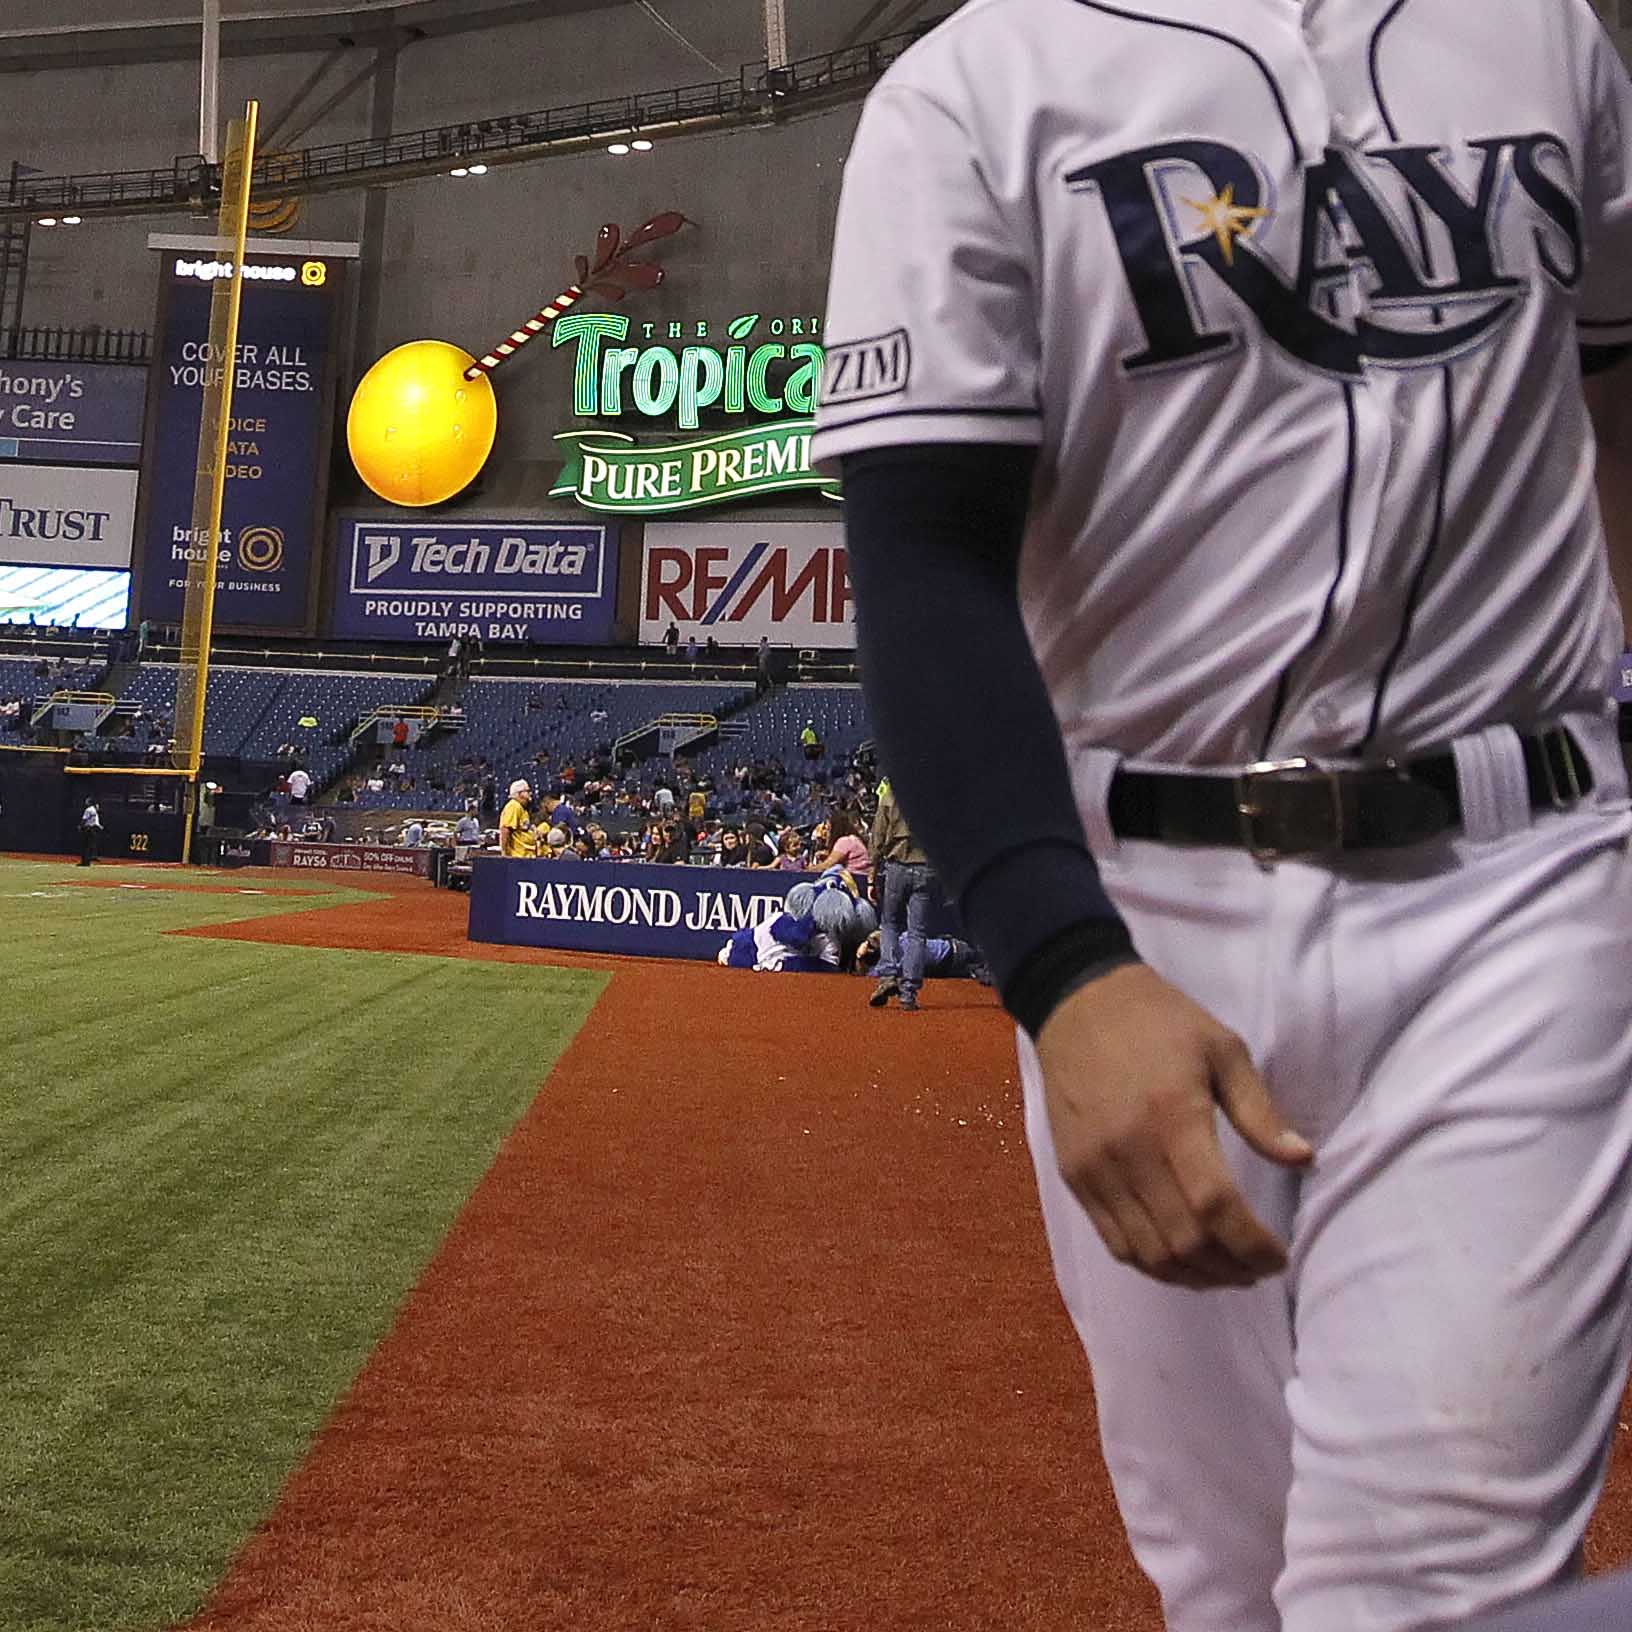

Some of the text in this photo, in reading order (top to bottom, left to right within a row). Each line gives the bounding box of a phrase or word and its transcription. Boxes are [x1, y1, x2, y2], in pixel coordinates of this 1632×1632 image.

[1065, 134, 1583, 374] RAYS
[641, 321, 708, 339] THE
[264, 344, 307, 367] ALL
[830, 339, 900, 396] ZIM
[235, 369, 314, 392] BASES.
[11, 404, 76, 432] Care
[581, 454, 682, 500] PURE
[171, 543, 232, 563] houe
[409, 536, 491, 574] Tech
[494, 536, 590, 576] Data
[228, 580, 281, 593] BUSINESS
[365, 600, 583, 620] PROUDLY SUPPORTING
[415, 621, 482, 640] TAMPA
[129, 833, 149, 852] 322
[293, 854, 328, 867] RAYS6
[515, 880, 681, 929] RAYMOND
